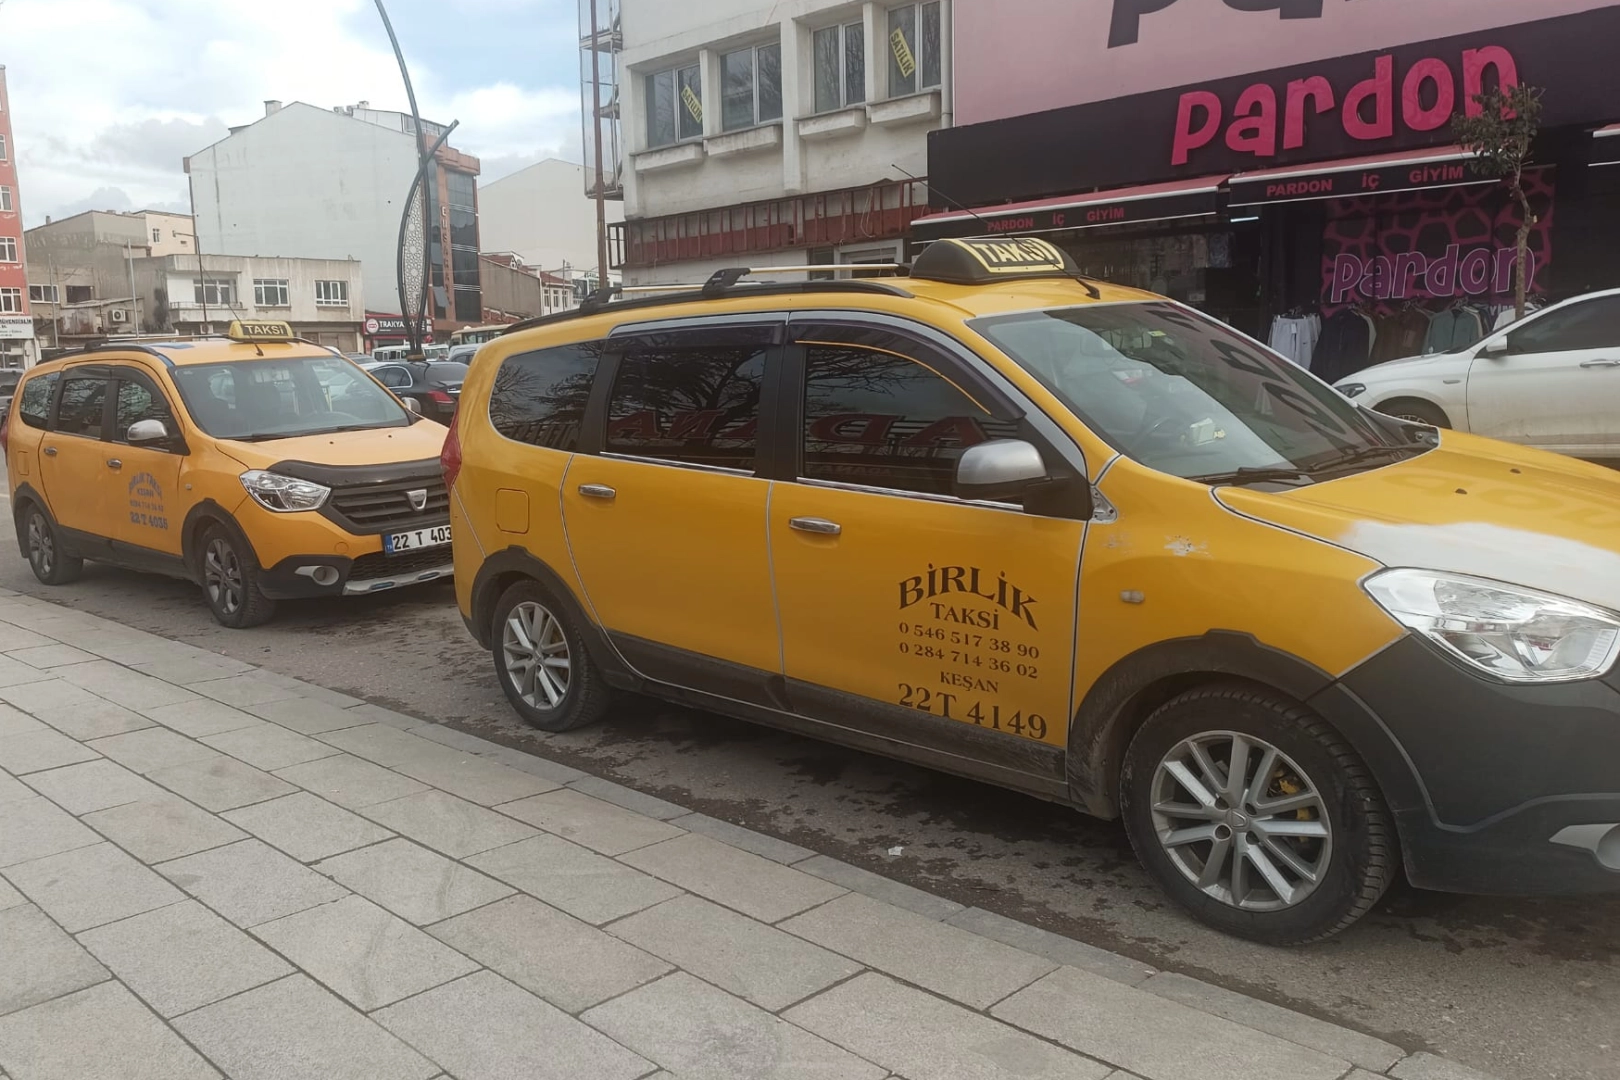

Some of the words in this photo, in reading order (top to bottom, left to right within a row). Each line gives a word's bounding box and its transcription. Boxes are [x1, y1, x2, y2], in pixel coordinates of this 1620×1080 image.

[890, 32, 914, 75] SATILIK
[1171, 45, 1518, 166] pardon
[1266, 178, 1333, 197] PARDON
[1361, 172, 1380, 189] İÇ
[1409, 164, 1464, 184] GİYİM
[986, 217, 1034, 232] PARDON
[1053, 212, 1065, 226] İÇ
[1086, 206, 1125, 221] GİYİM
[970, 238, 1055, 263] TAKSİ
[1331, 243, 1535, 303] pardon
[244, 325, 284, 335] TAKSİ
[379, 320, 405, 328] TRAKYA
[393, 534, 410, 550] 22
[415, 531, 423, 545] T
[431, 526, 452, 543] 403
[899, 563, 1039, 632] BİRLİK
[930, 601, 999, 630] TAKSİ
[899, 622, 909, 634] 0
[913, 624, 945, 641] 546
[950, 631, 983, 647] 517
[989, 638, 1011, 653] 38
[1017, 643, 1039, 659] 90
[899, 642, 909, 653] 0
[914, 644, 945, 660] 284
[951, 650, 983, 667] 714
[989, 657, 1011, 673] 36
[1016, 663, 1038, 679] 02
[940, 671, 999, 693] KEŞAN
[966, 701, 1047, 740] 4149
